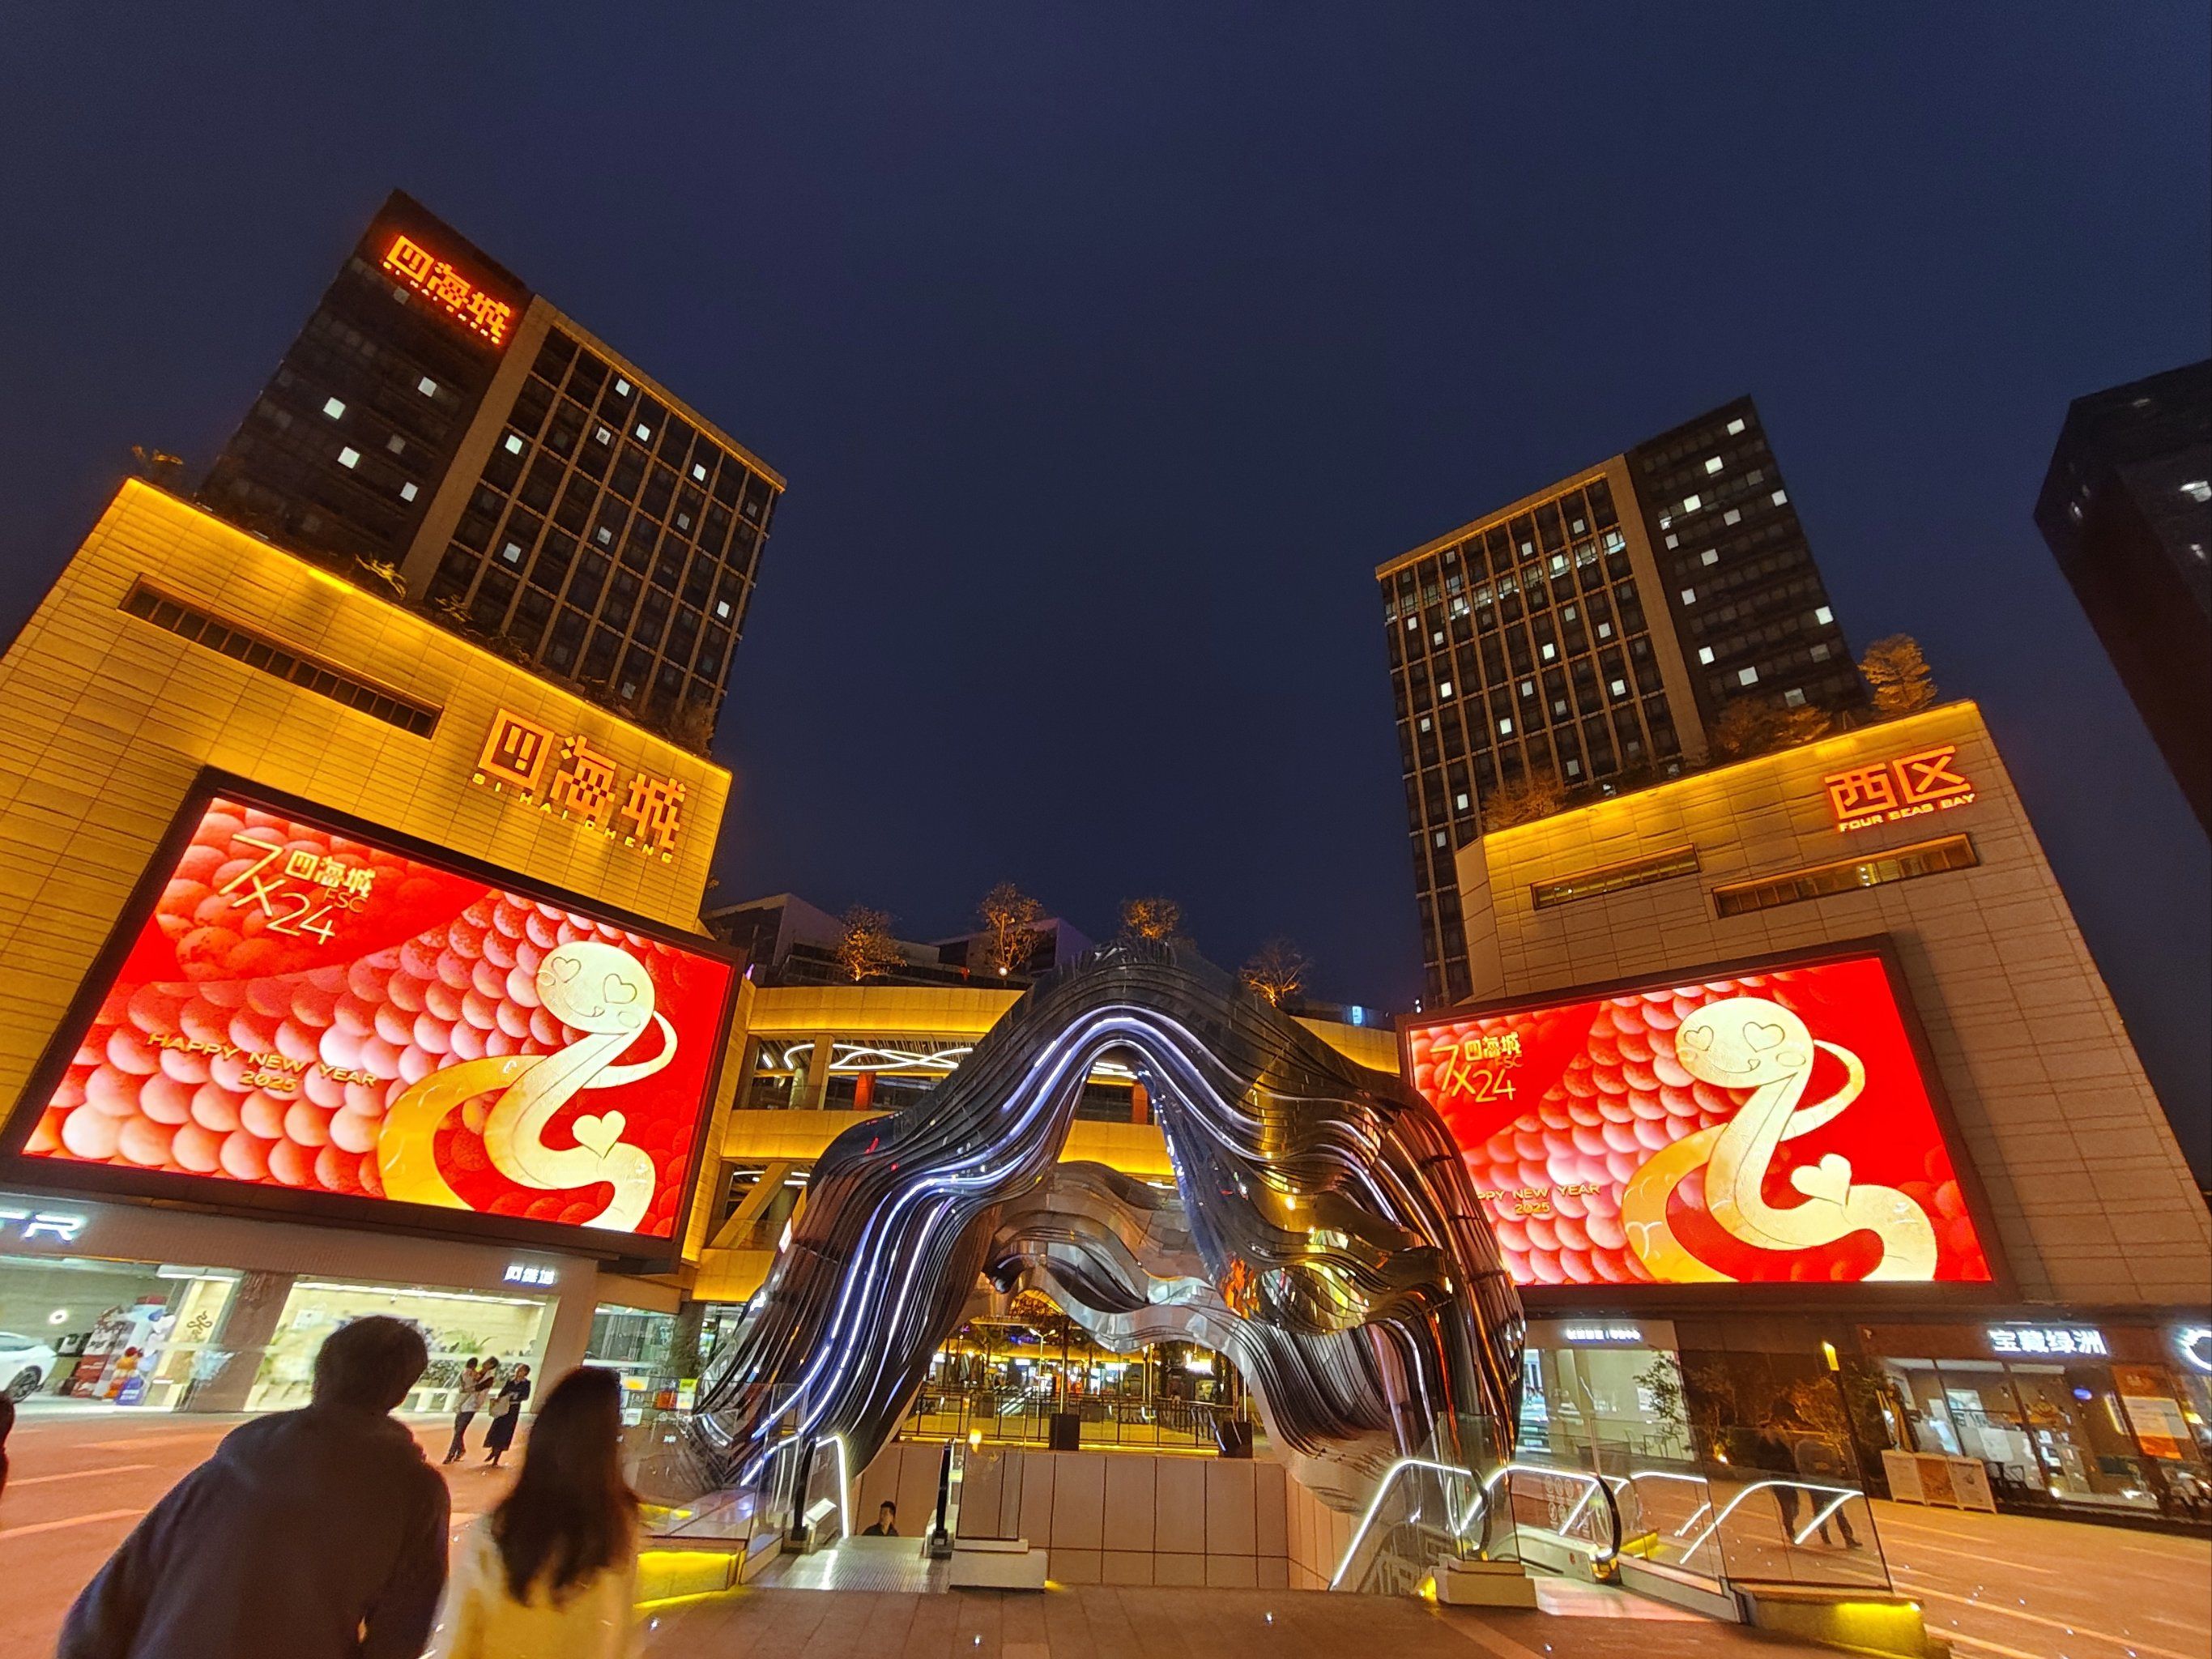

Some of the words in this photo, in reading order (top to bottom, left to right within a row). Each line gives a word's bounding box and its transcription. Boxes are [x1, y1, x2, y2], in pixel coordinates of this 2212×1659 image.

[386, 235, 510, 337] 四海城
[478, 707, 686, 849] 四海城
[1825, 745, 1971, 820] 西区
[1839, 814, 1883, 833] FOUR
[1889, 802, 1935, 821] SEAS
[1940, 792, 1975, 810] BAY
[284, 849, 376, 899] 四海城
[324, 887, 368, 914] FSC
[147, 1032, 241, 1061] HAPPY
[248, 1051, 308, 1073] NEW
[320, 1063, 379, 1088] YEAR
[239, 1070, 299, 1093] 2025
[1477, 1191, 1505, 1201] PPY
[1512, 1188, 1549, 1200] NEW
[1557, 1183, 1600, 1197] YEAR
[1515, 1201, 1550, 1214] 2025
